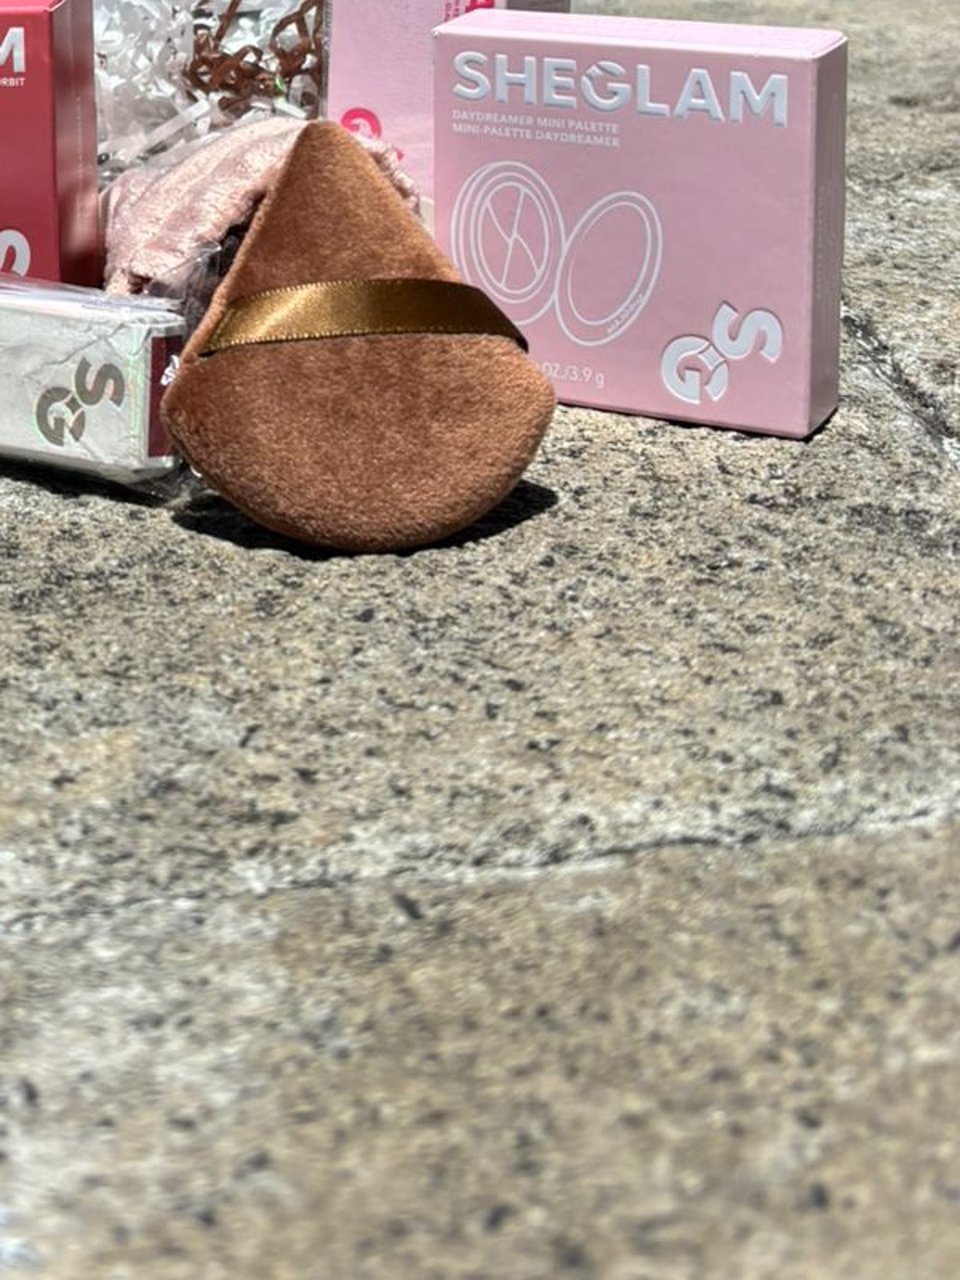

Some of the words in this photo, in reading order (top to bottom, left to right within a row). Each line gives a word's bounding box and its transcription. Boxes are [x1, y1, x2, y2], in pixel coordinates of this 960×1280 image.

[453, 51, 788, 128] SHEGLAM
[451, 109, 534, 126] DAYDREAMER
[537, 117, 565, 129] MINI
[567, 119, 620, 133] PALETTE
[535, 129, 621, 147] DAYDREAMER
